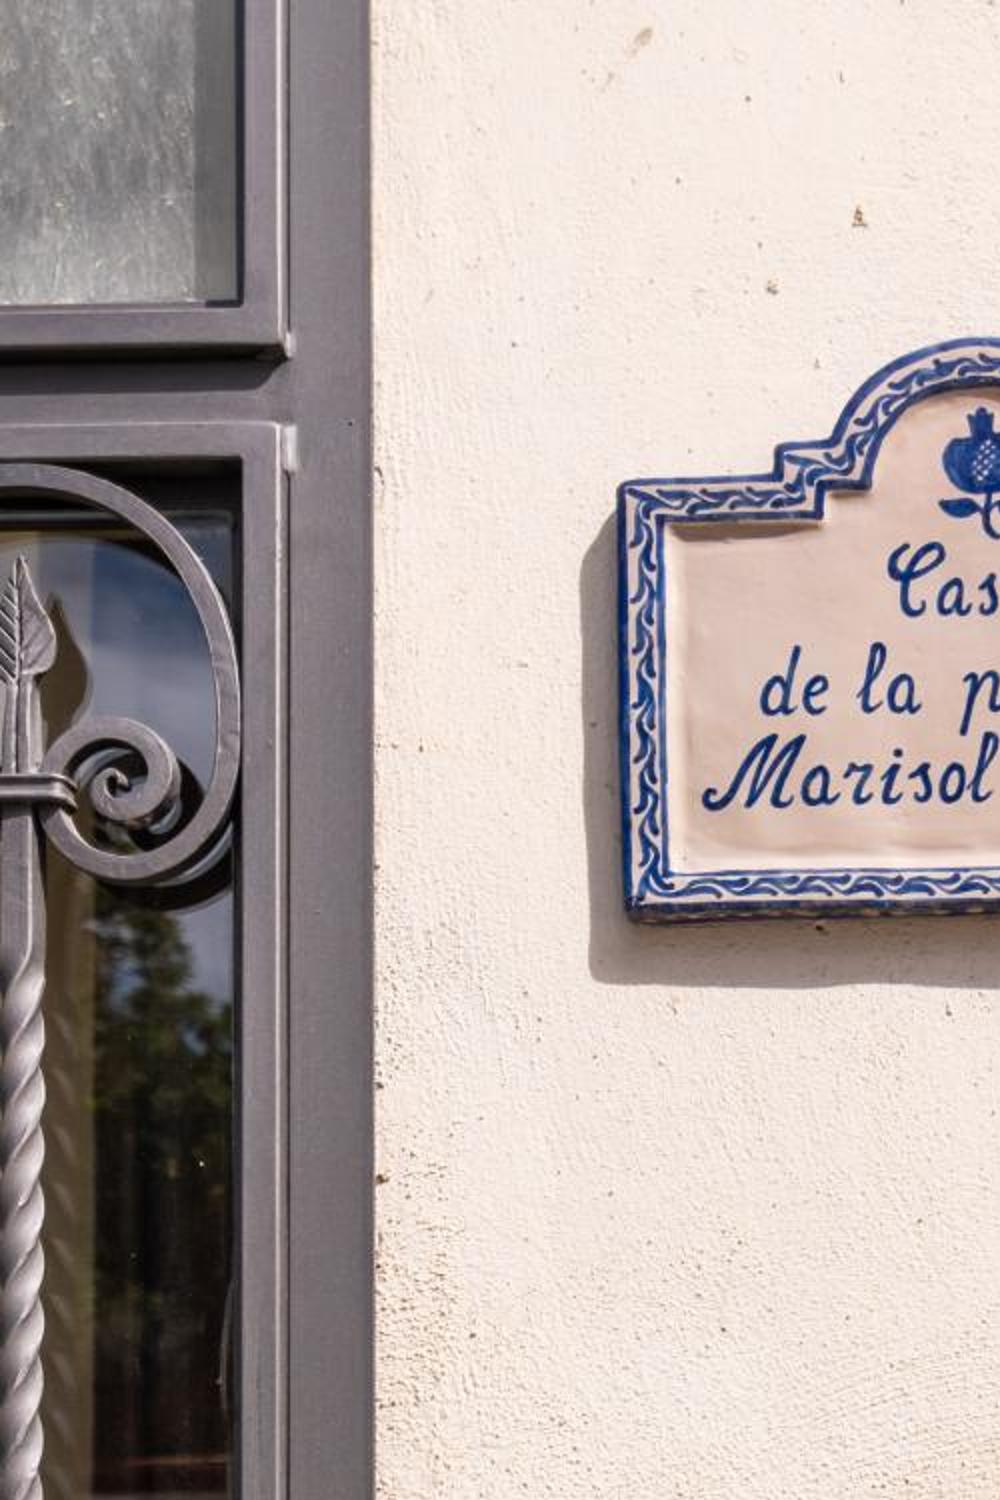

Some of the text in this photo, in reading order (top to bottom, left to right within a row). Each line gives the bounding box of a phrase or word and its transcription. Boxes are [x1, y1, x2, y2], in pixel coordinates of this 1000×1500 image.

[760, 645, 828, 717] de
[856, 642, 921, 715] la
[702, 732, 999, 812] Marisol
